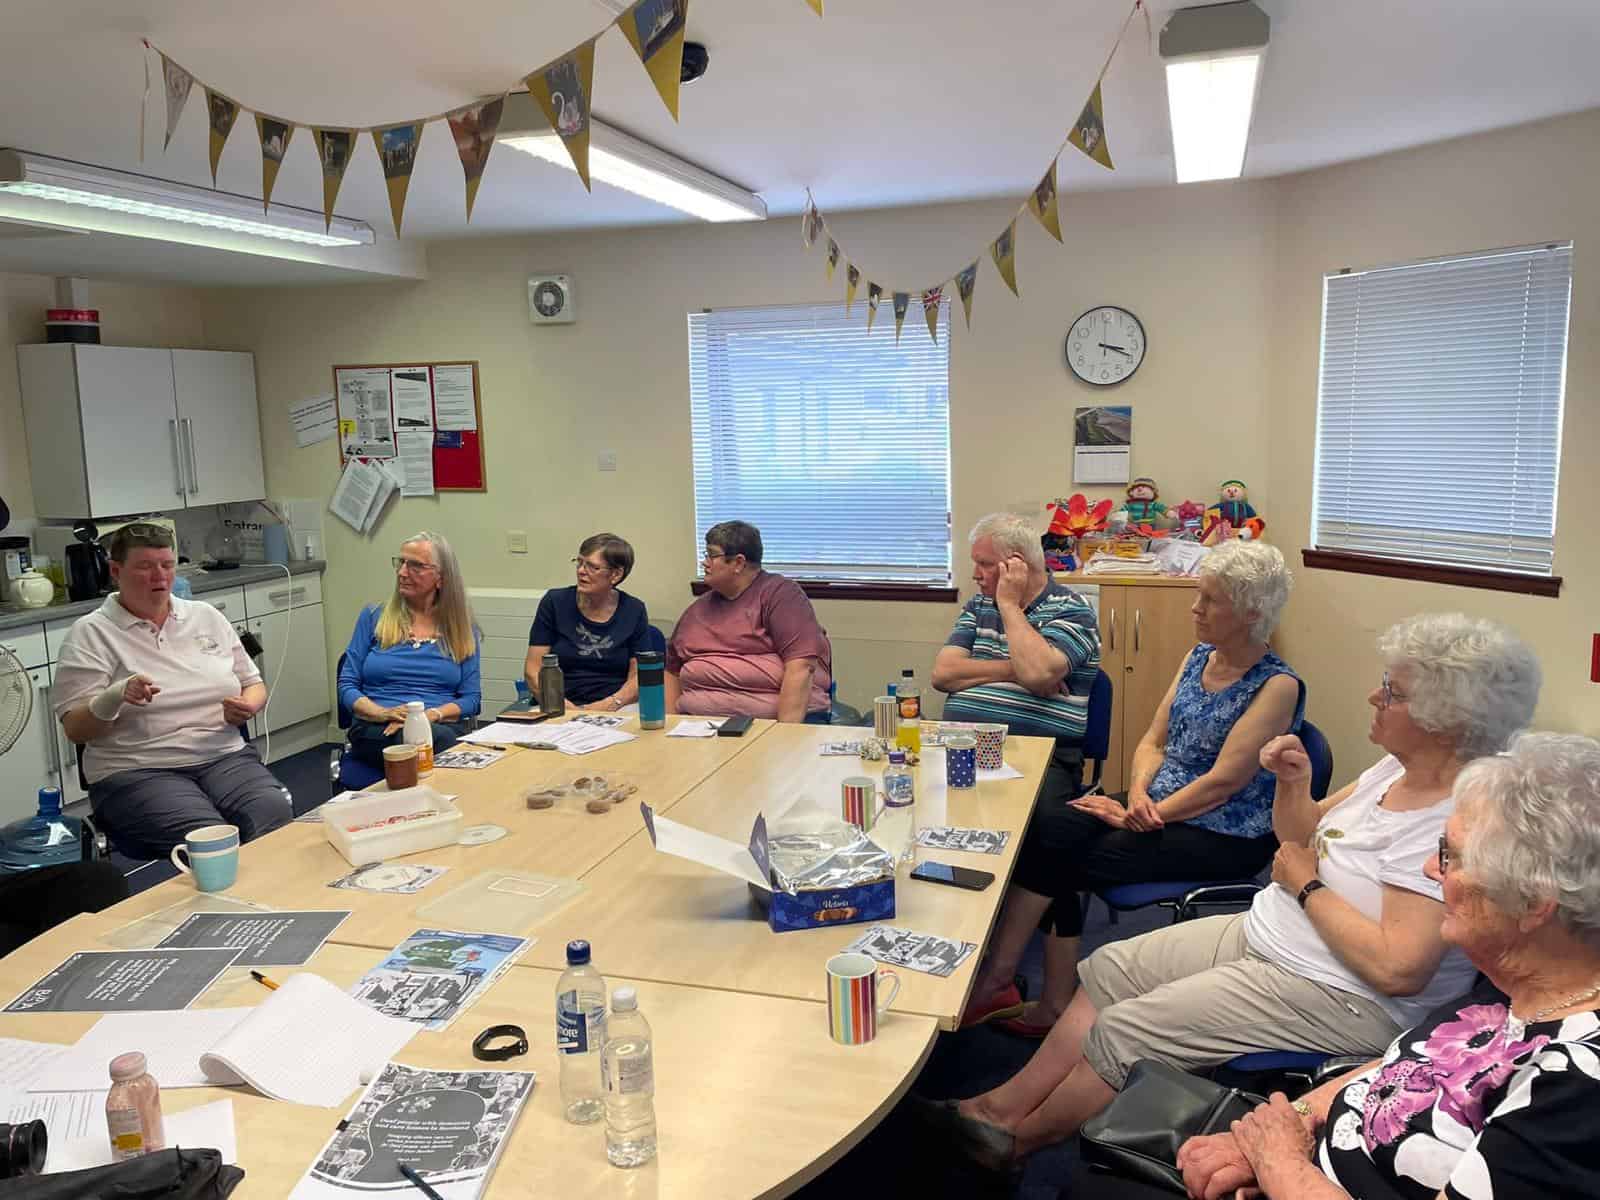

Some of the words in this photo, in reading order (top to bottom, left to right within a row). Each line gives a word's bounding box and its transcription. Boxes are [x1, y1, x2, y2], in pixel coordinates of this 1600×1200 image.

[1089, 315, 1096, 328] 11
[1101, 312, 1112, 323] 12
[1077, 327, 1089, 338] 10
[1101, 369, 1109, 379] 6
